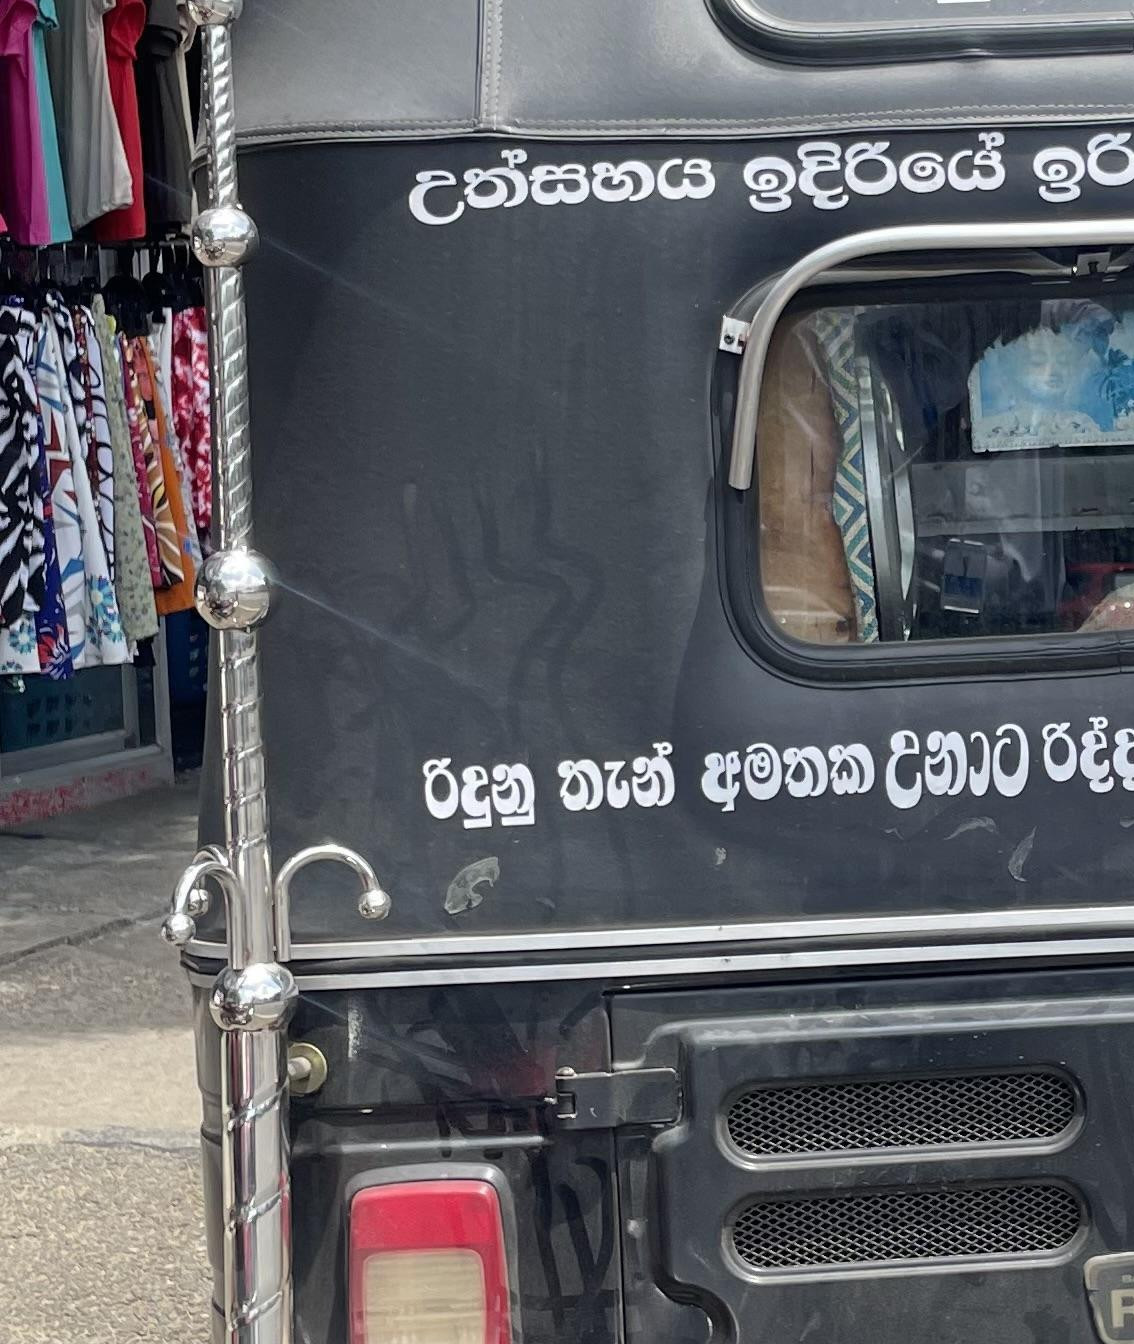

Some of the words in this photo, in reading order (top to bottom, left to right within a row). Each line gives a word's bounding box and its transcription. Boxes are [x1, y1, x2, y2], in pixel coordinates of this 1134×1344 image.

[409, 149, 716, 226] උත්සහය
[743, 133, 1006, 213] ඉදිරියේ
[422, 757, 536, 830] රිදුනු
[557, 741, 676, 812] තැන්
[701, 742, 876, 813] අමතක
[885, 723, 1030, 810] උනාට
